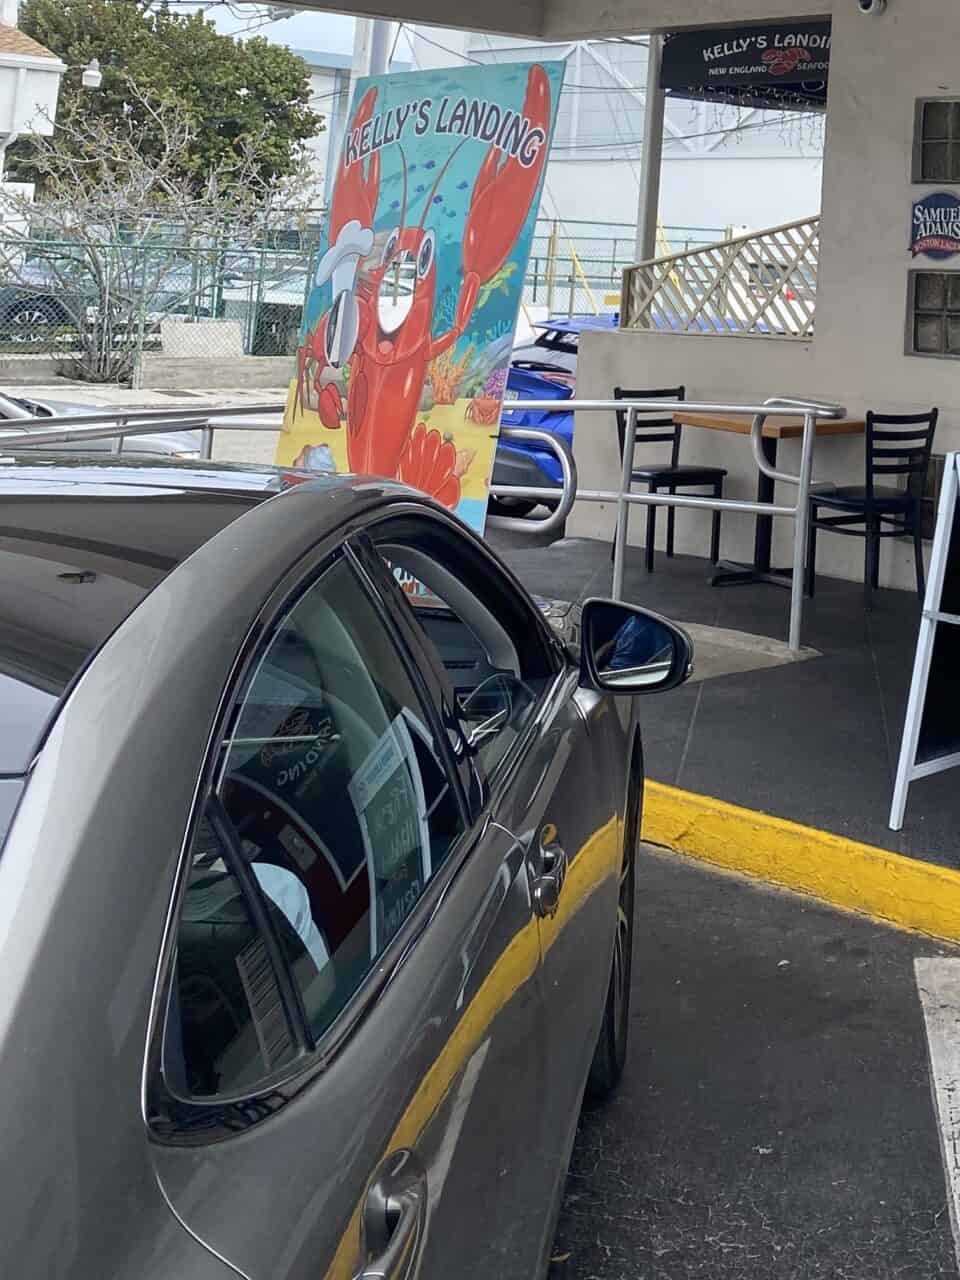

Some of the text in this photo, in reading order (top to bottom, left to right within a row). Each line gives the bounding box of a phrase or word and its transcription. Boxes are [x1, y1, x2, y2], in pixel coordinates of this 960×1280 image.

[703, 36, 768, 62] KELLY'S
[709, 67, 727, 75] NEW
[729, 65, 767, 74] ENGLAND
[344, 96, 546, 168] KELLY'S LANDING
